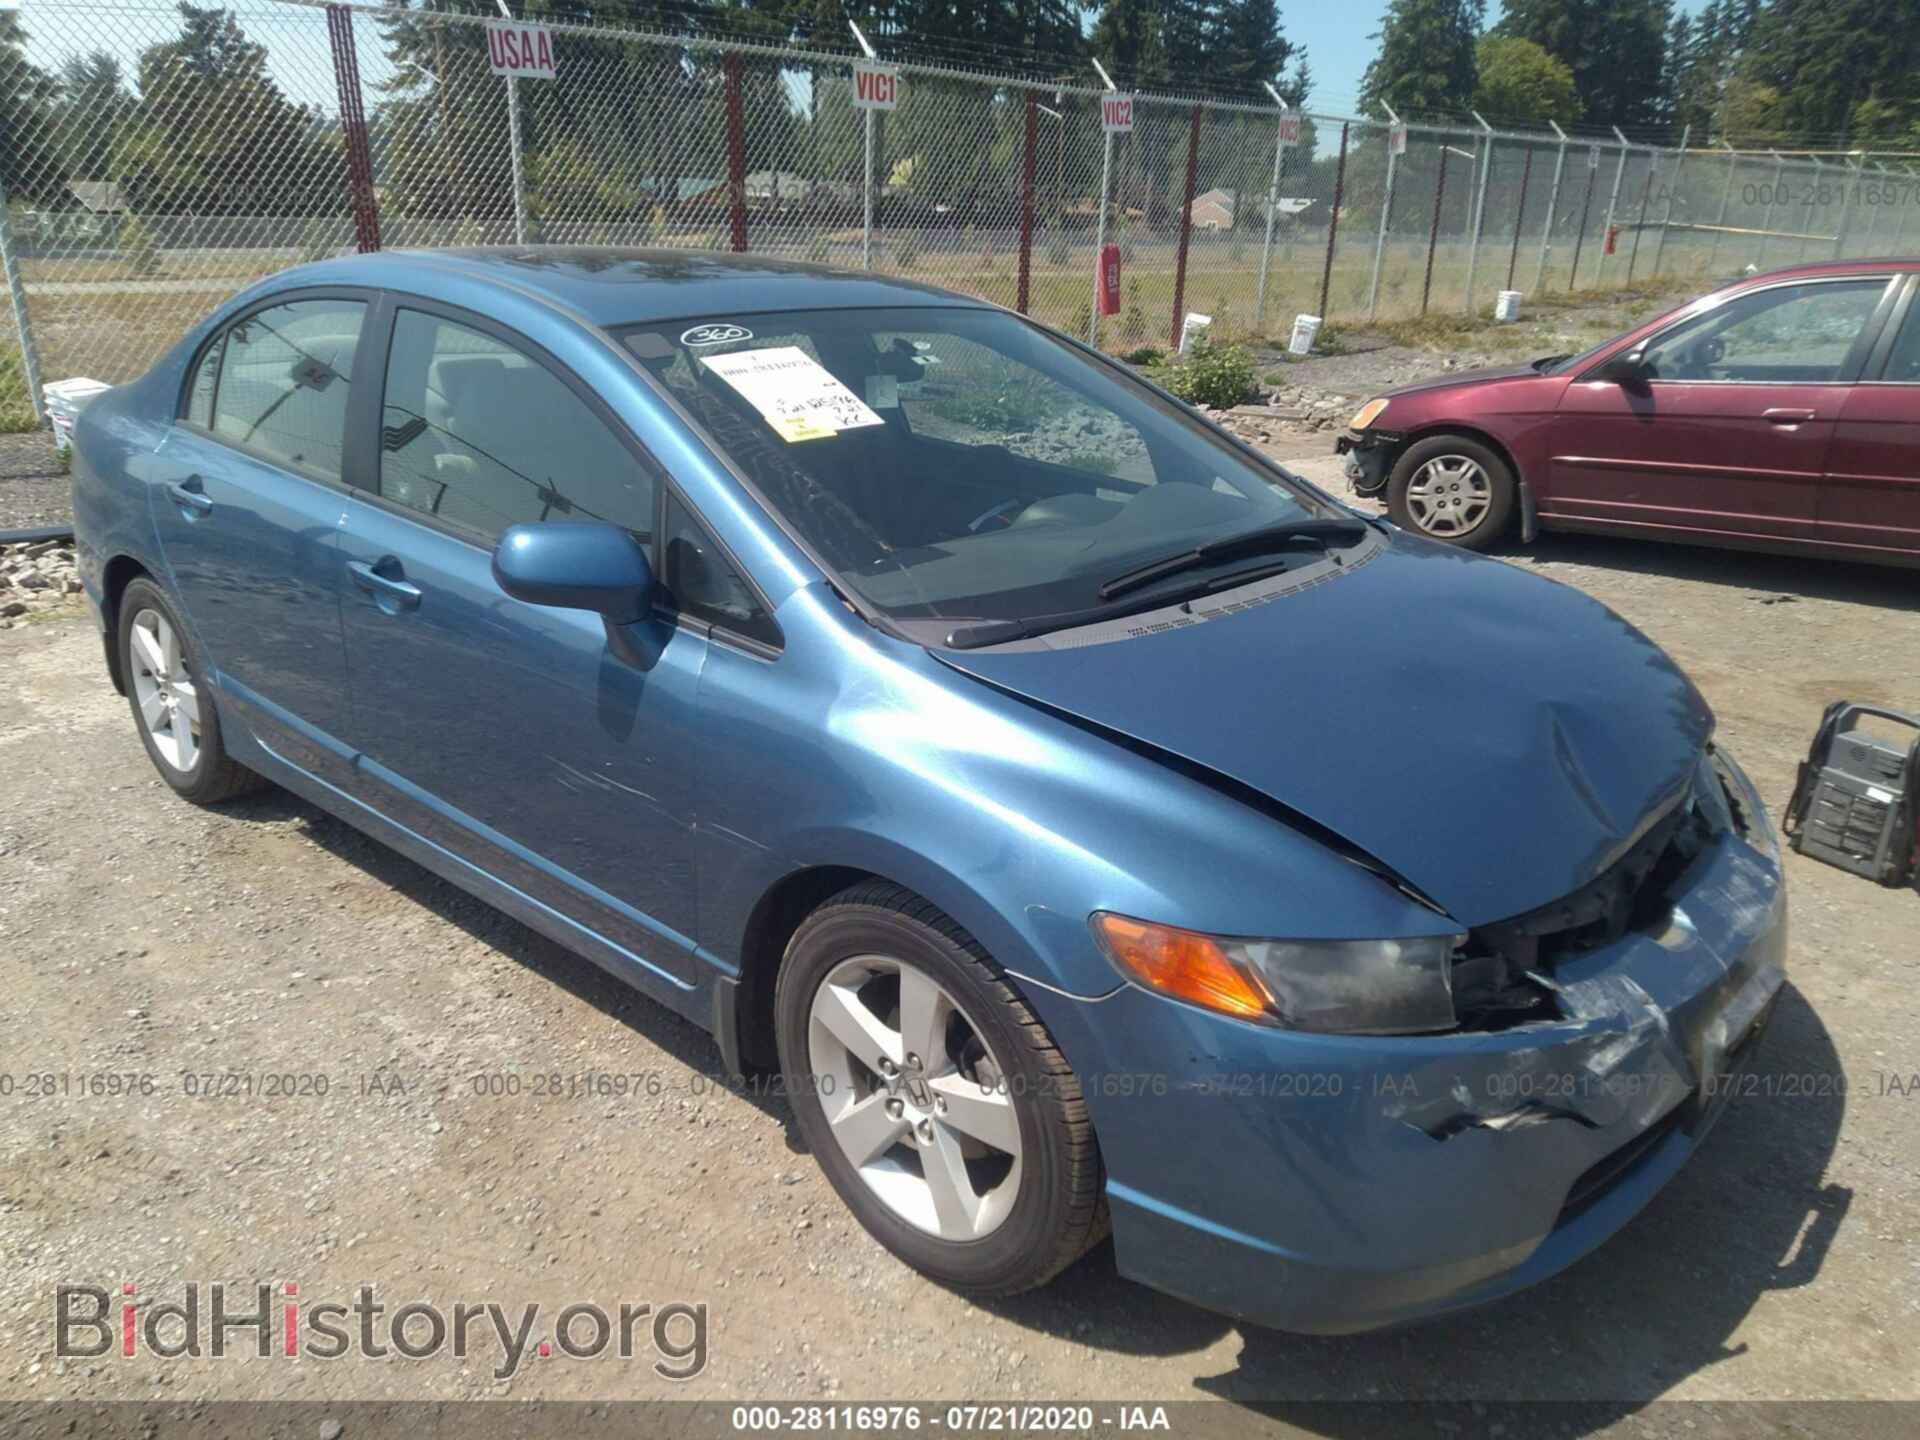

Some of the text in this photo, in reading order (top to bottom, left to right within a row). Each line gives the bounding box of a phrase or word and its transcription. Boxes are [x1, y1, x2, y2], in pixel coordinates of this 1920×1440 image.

[489, 29, 553, 71] USAA
[856, 71, 895, 103] VIC1
[1103, 101, 1131, 125] VIC2
[691, 327, 744, 343] 360
